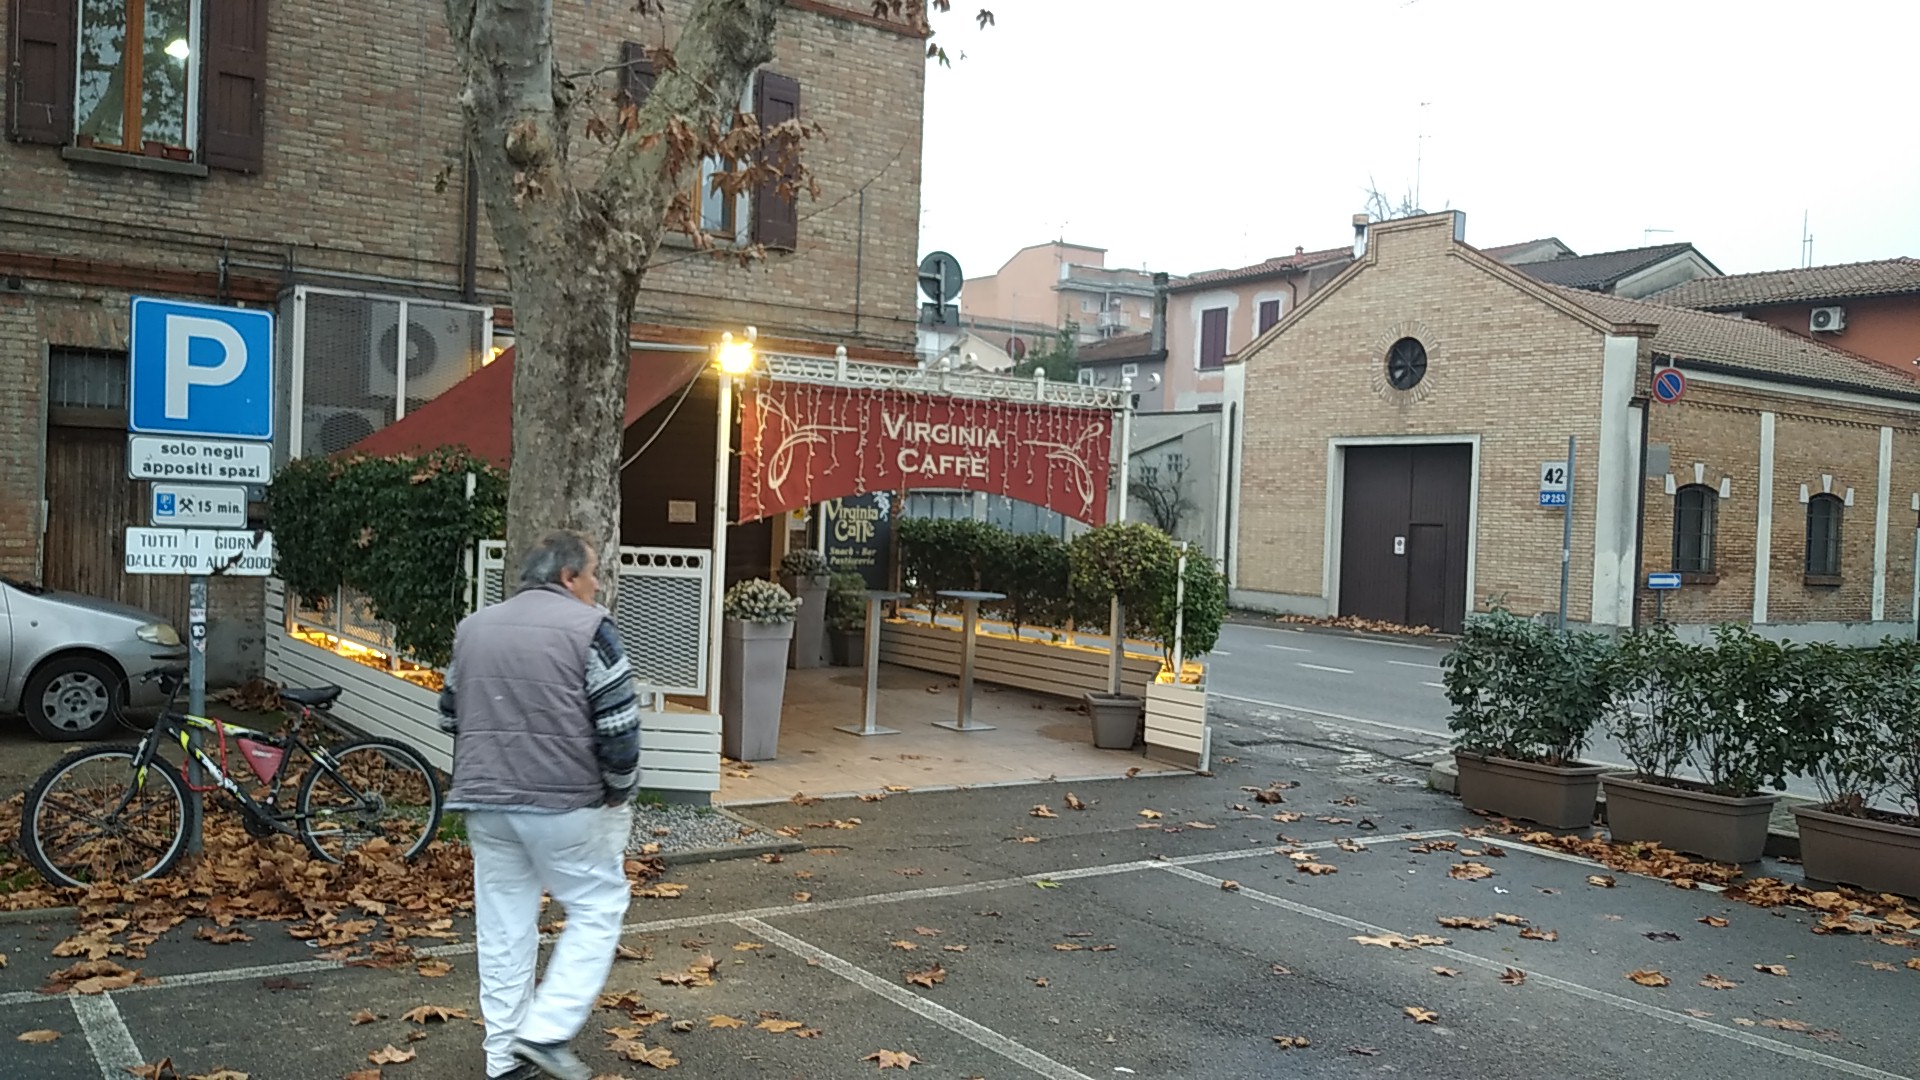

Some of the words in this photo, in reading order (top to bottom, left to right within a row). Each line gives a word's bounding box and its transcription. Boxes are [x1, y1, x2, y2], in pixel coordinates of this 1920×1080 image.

[165, 313, 248, 420] P
[161, 442, 197, 456] solo
[203, 445, 244, 460] negli
[142, 461, 213, 476] appositi
[219, 465, 260, 478] spazi
[1544, 467, 1564, 485] 42
[1541, 493, 1551, 503] SP
[1551, 493, 1566, 503] 253
[198, 500, 212, 512] 15
[217, 502, 242, 514] min.
[826, 497, 879, 523] Virginia
[140, 534, 178, 548] TUTTI
[194, 535, 199, 549] I
[215, 536, 259, 550] GIORN
[126, 554, 168, 567] DALLE
[171, 555, 197, 568] 700
[238, 556, 272, 569] 2000
